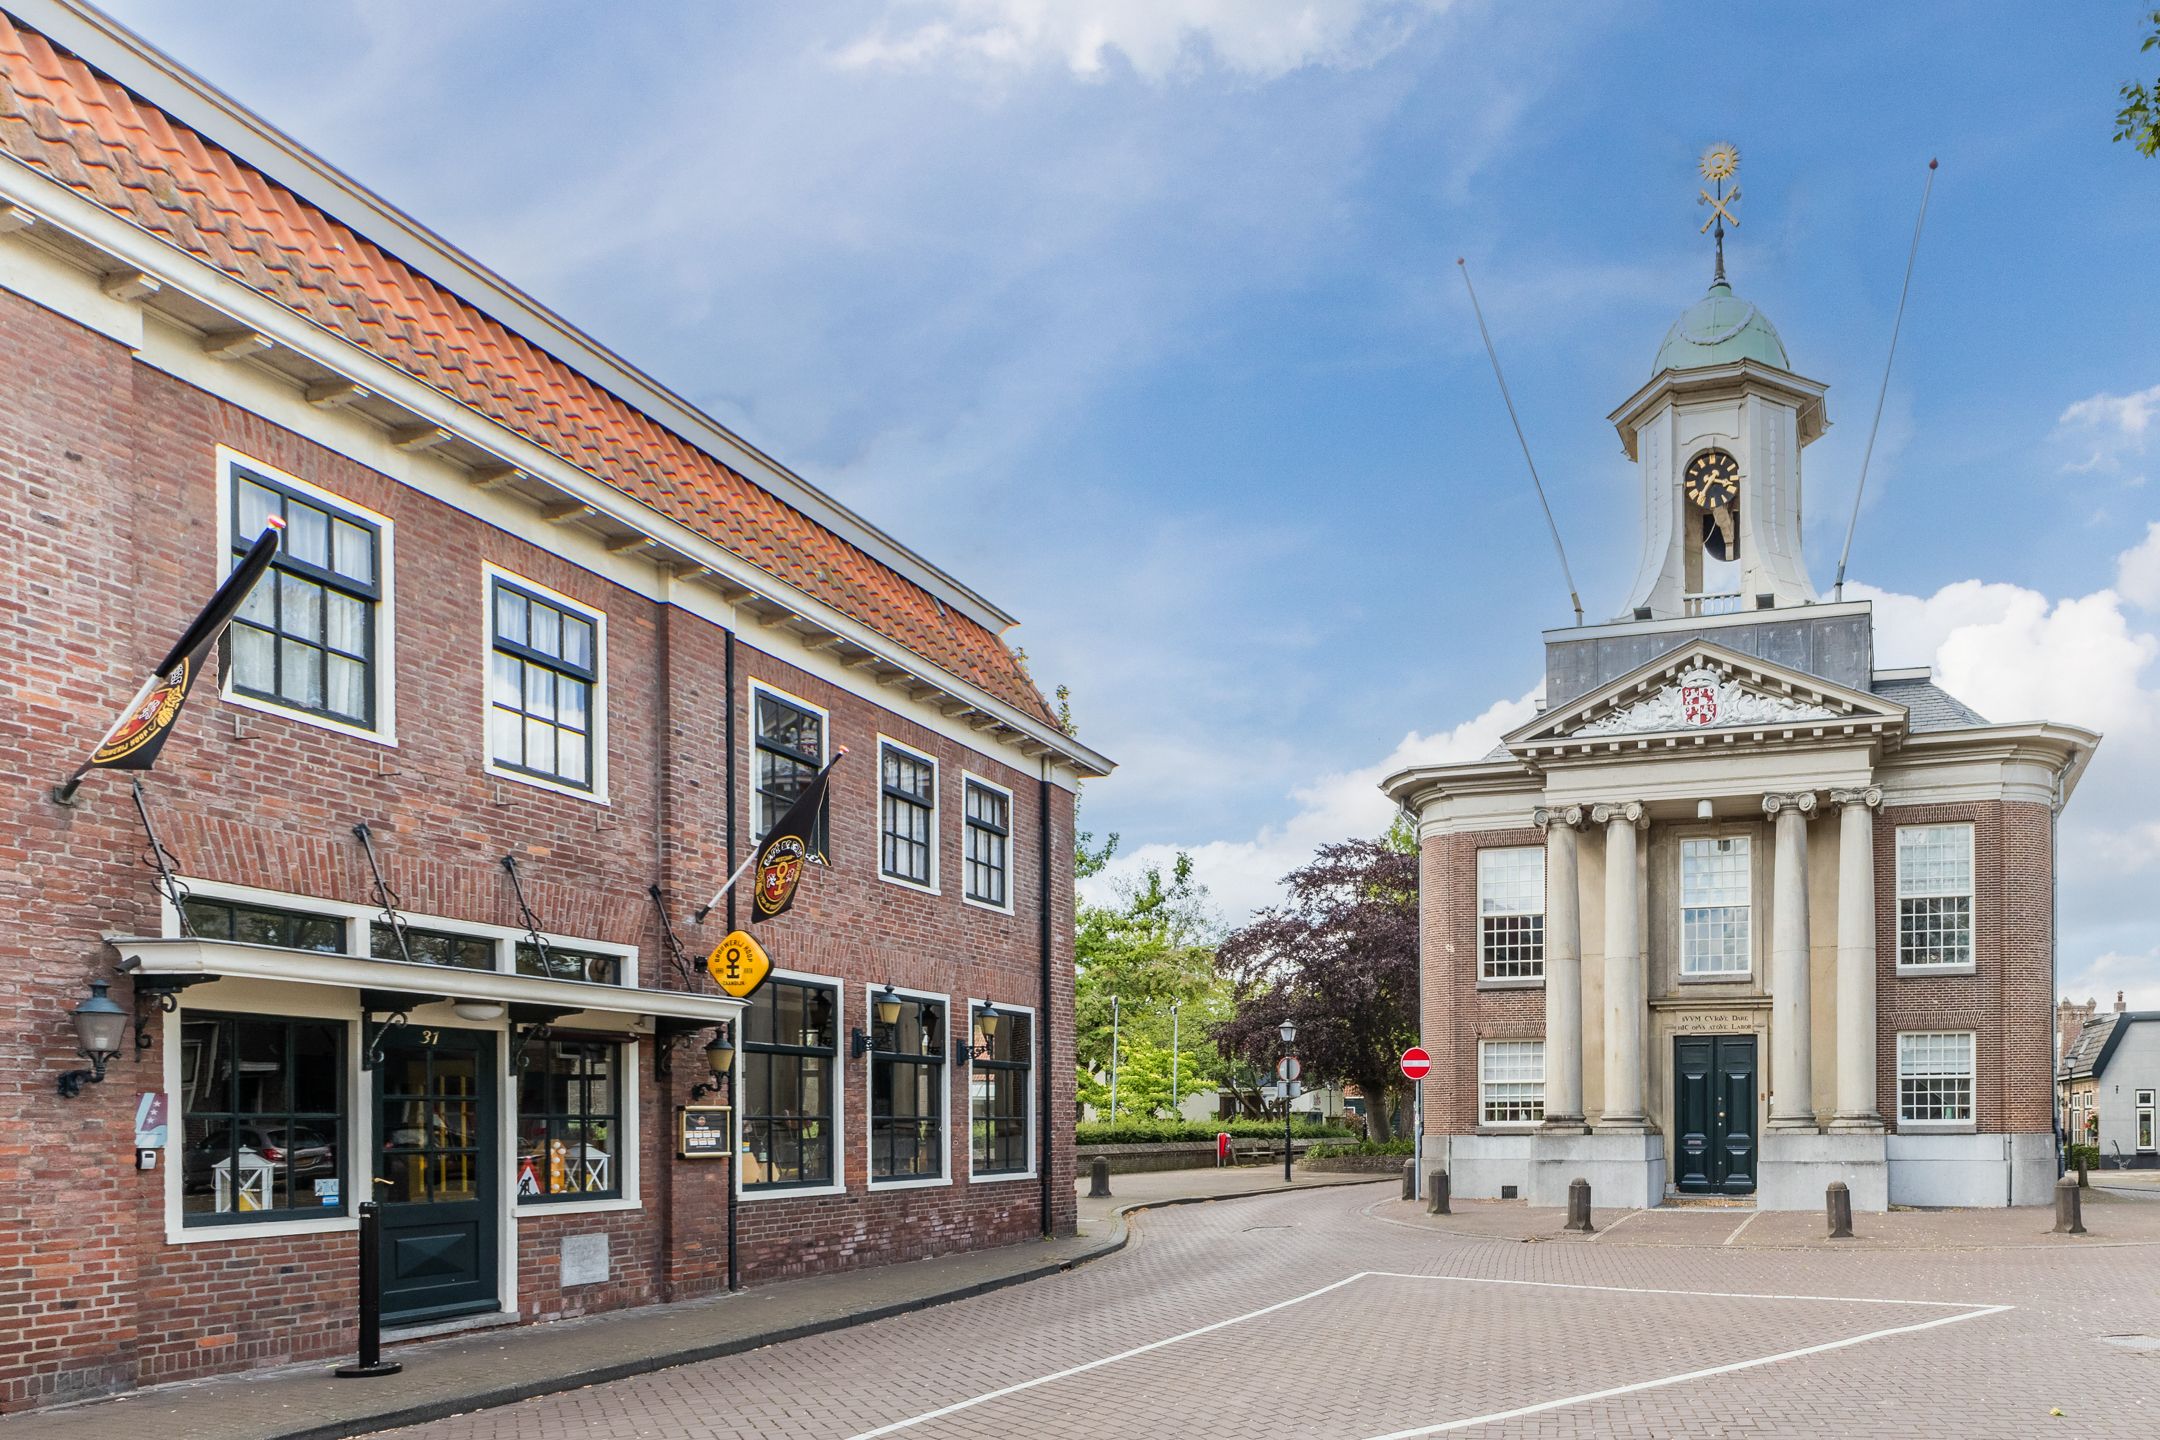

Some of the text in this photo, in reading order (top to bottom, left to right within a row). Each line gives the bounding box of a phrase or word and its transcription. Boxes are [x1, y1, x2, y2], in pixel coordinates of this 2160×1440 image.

[715, 940, 752, 962] BROUWERIJ HOOP
[419, 1030, 440, 1045] 31
